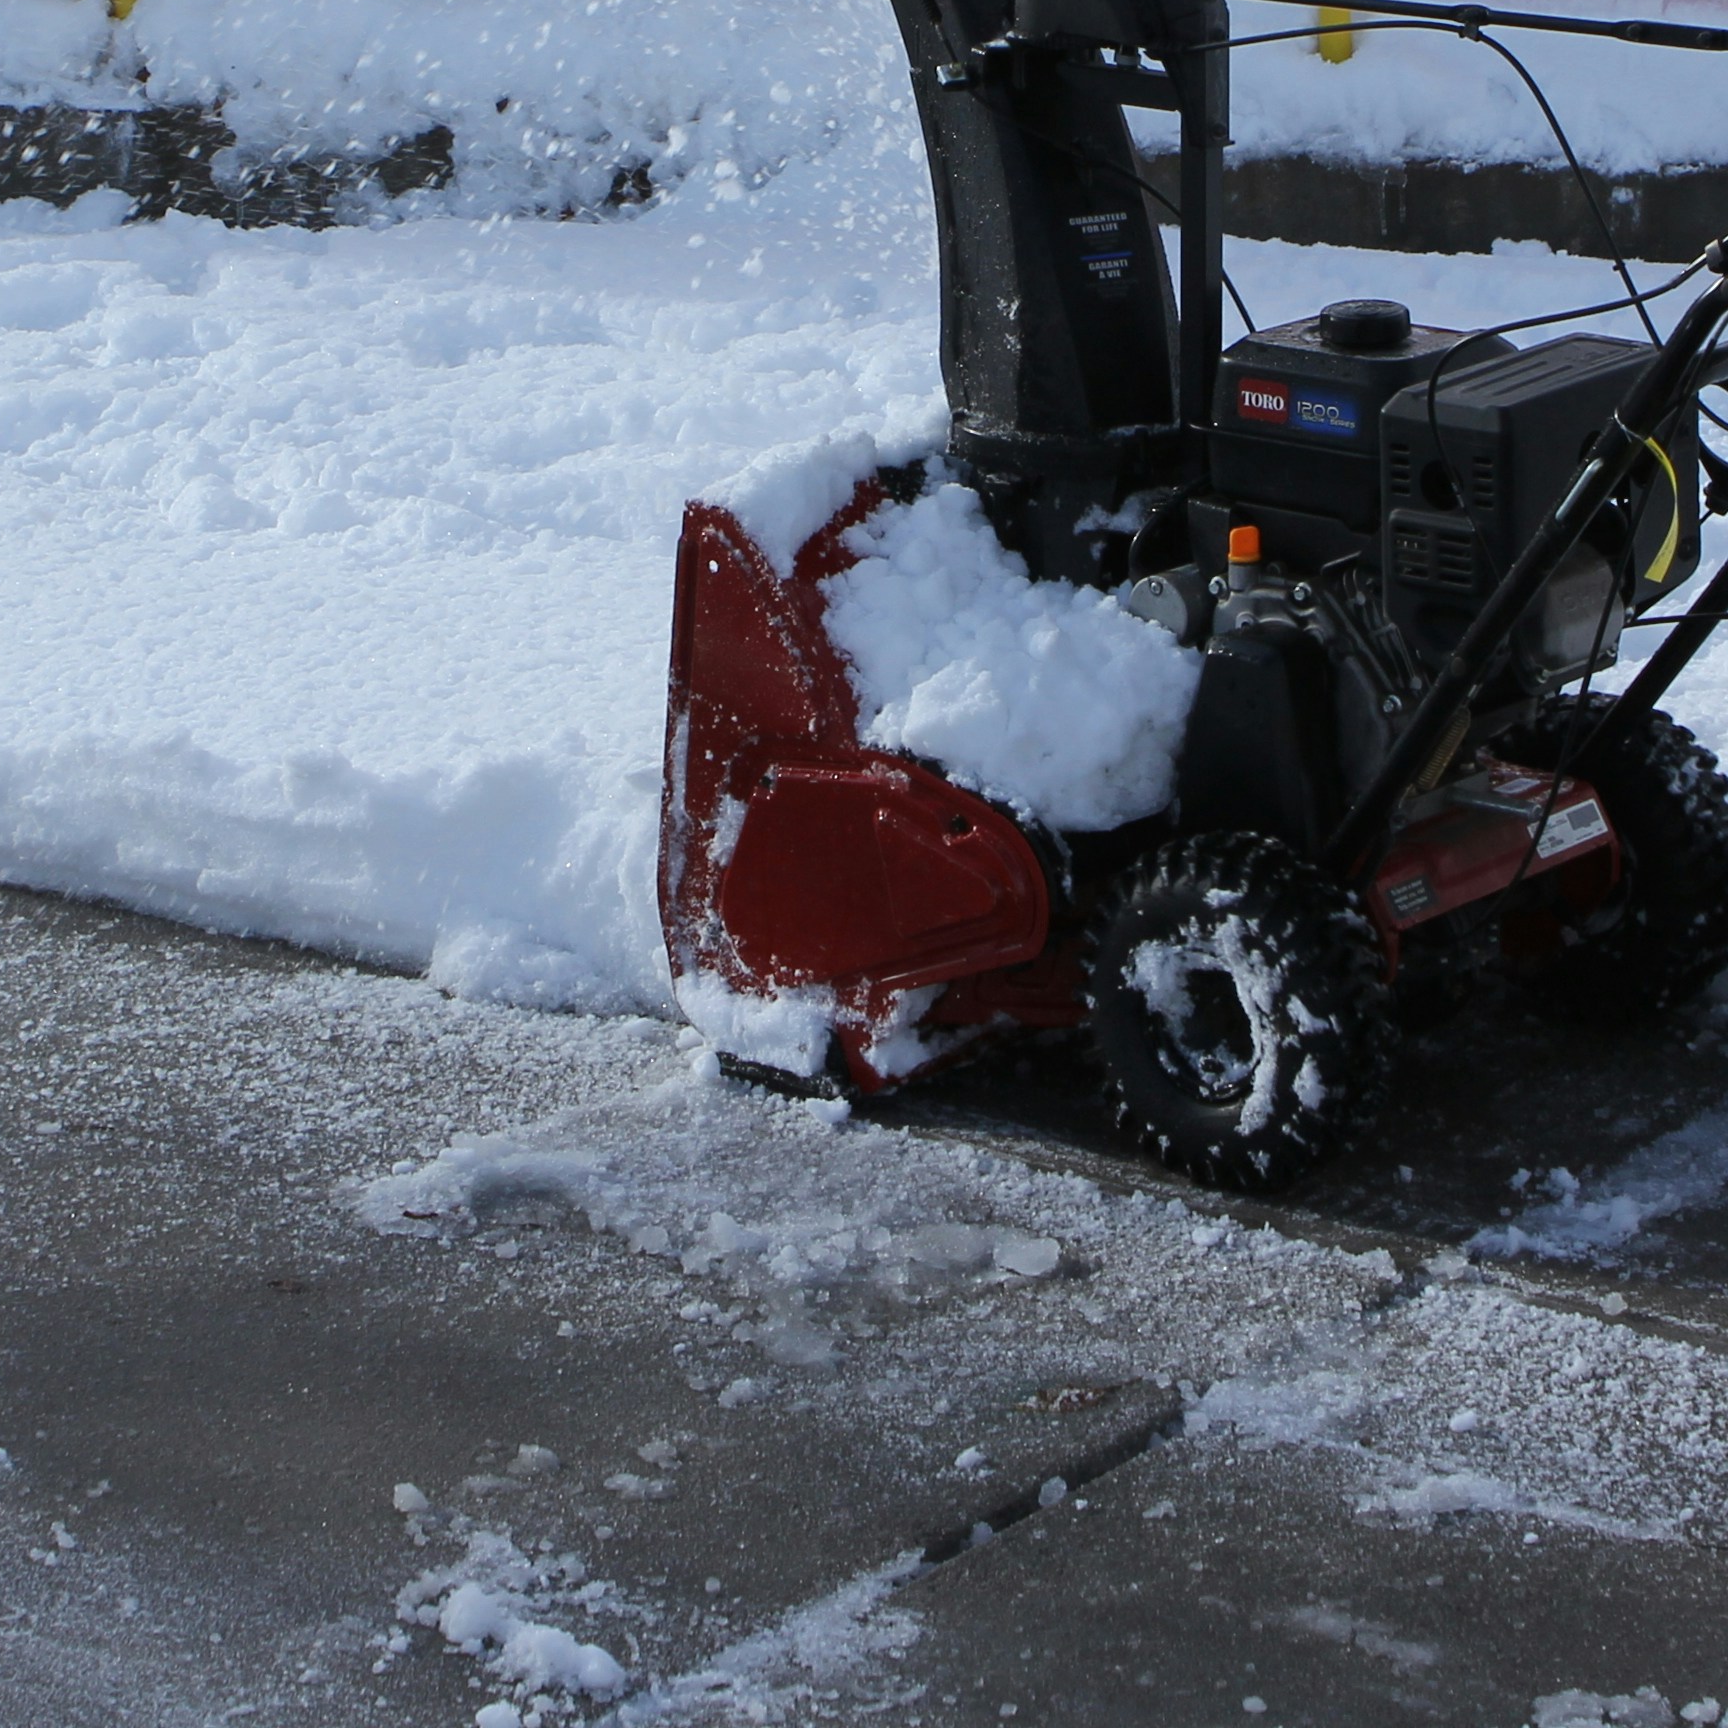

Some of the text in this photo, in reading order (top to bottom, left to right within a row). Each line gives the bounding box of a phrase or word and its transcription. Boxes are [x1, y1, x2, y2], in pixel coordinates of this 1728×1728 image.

[1069, 212, 1127, 225] GUARANTEED
[1082, 223, 1119, 234] FOR LIFE
[1089, 259, 1128, 271] GARANTI
[1241, 390, 1284, 411] TORO
[1297, 401, 1340, 420] 1200
